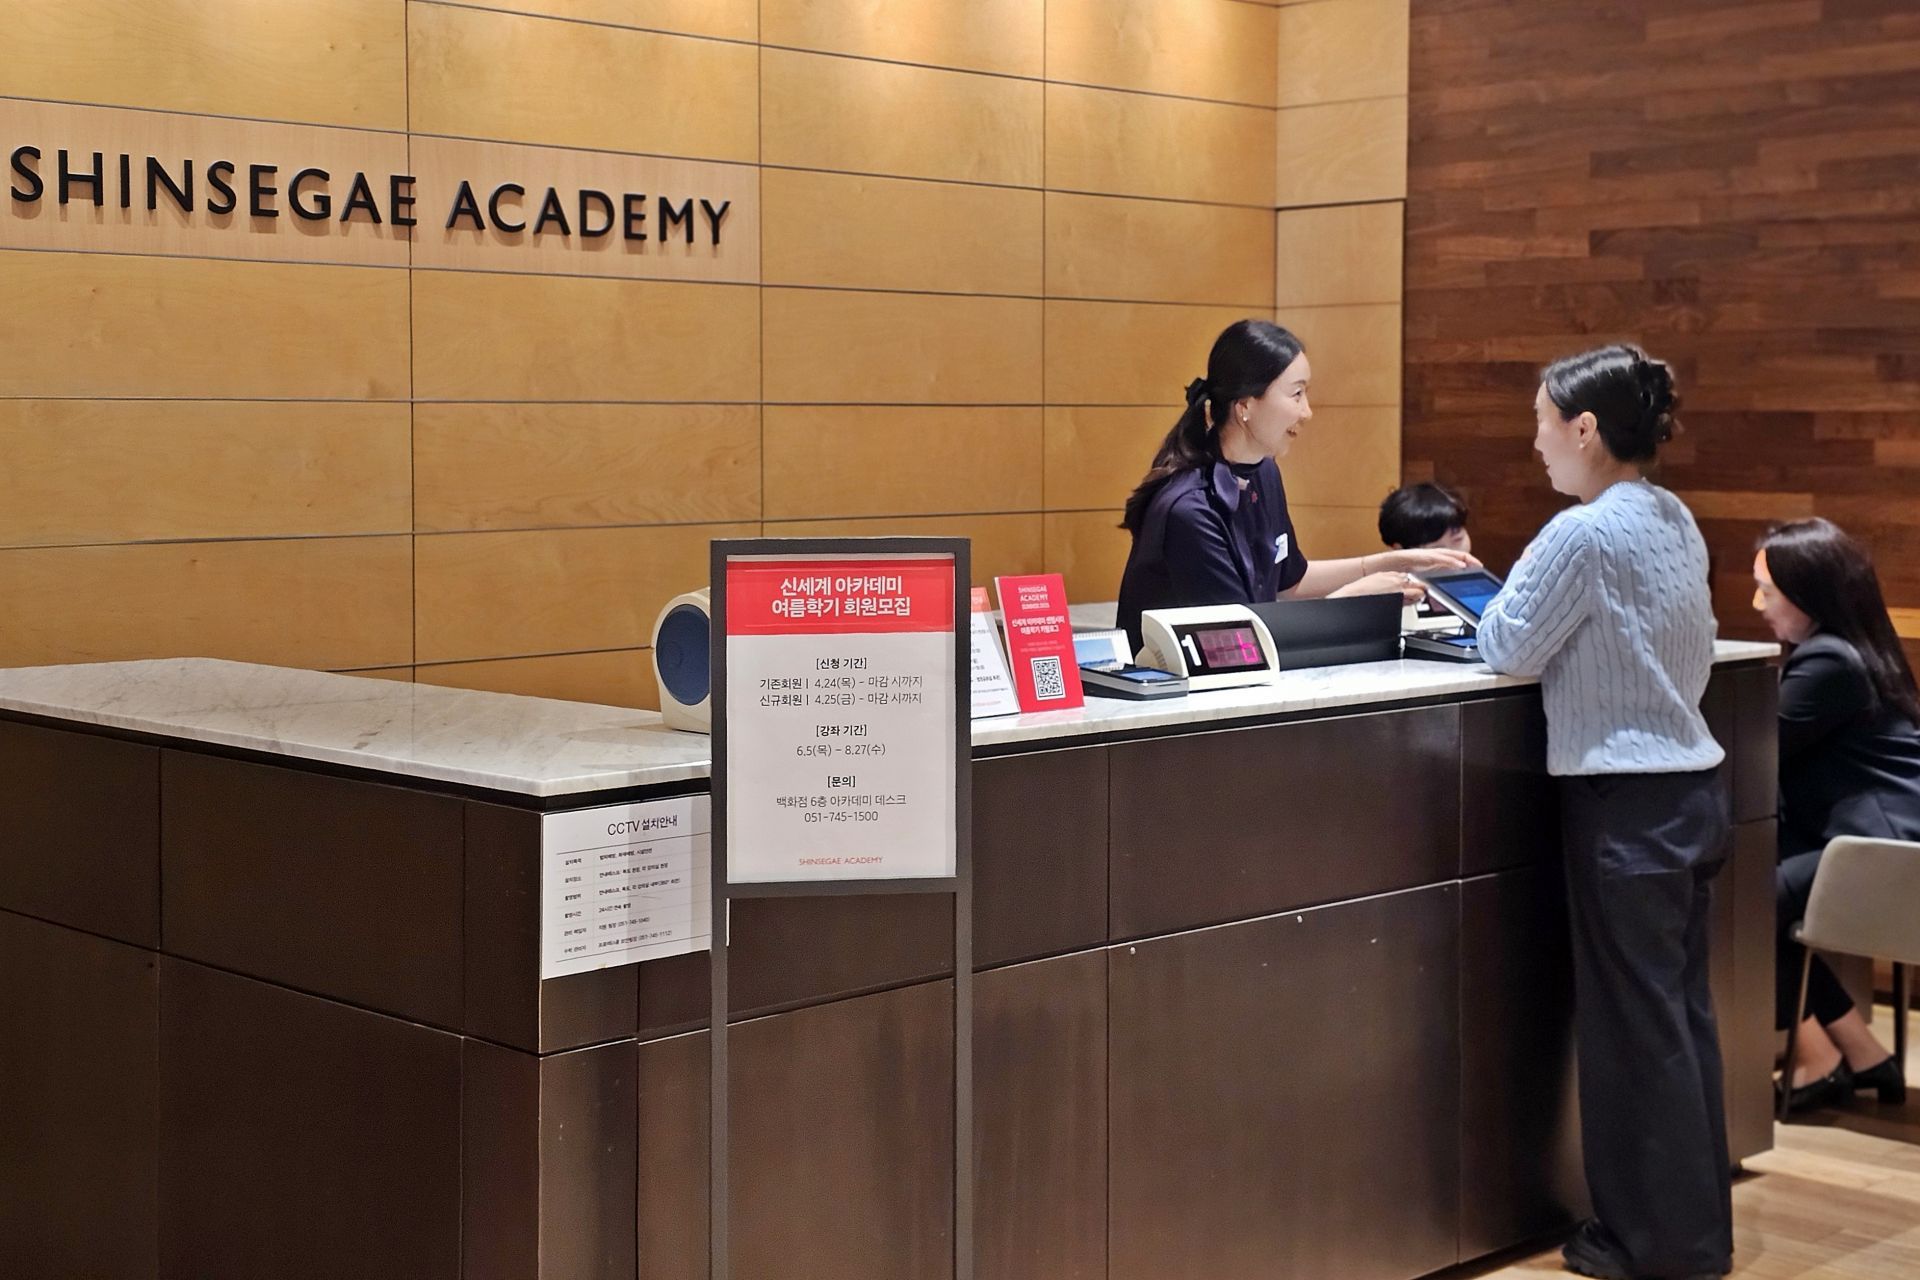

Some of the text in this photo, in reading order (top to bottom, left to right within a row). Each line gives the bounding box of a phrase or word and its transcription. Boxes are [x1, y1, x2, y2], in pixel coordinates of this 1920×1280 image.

[9, 145, 731, 246] SHINSEGAE ACADEMY
[780, 575, 902, 597] 신세계 아카데미
[771, 596, 911, 618] 여름학기 회원모집
[1181, 633, 1203, 667] 1
[816, 657, 867, 670] [신청 기간]
[759, 678, 802, 690] 기존회원
[814, 677, 856, 689] 4.24(목)
[868, 676, 889, 688] 마감
[891, 675, 923, 688] 시까지
[759, 695, 802, 707] 신규회원
[814, 693, 856, 706] 4.25(금)
[867, 693, 889, 705] 마감
[891, 692, 922, 704] 시까지
[816, 724, 867, 737] [강좌 기간]
[796, 744, 832, 757] 6.5(목)
[844, 743, 886, 756] 8.27(수)
[827, 775, 856, 788] [문의]
[776, 794, 907, 808] 백화점 6층 아카데미 데스크
[804, 811, 879, 823] 051-745-1500
[607, 815, 678, 836] CCTV 설치안내
[799, 856, 883, 866] SHINSEGAE ACADEMY
